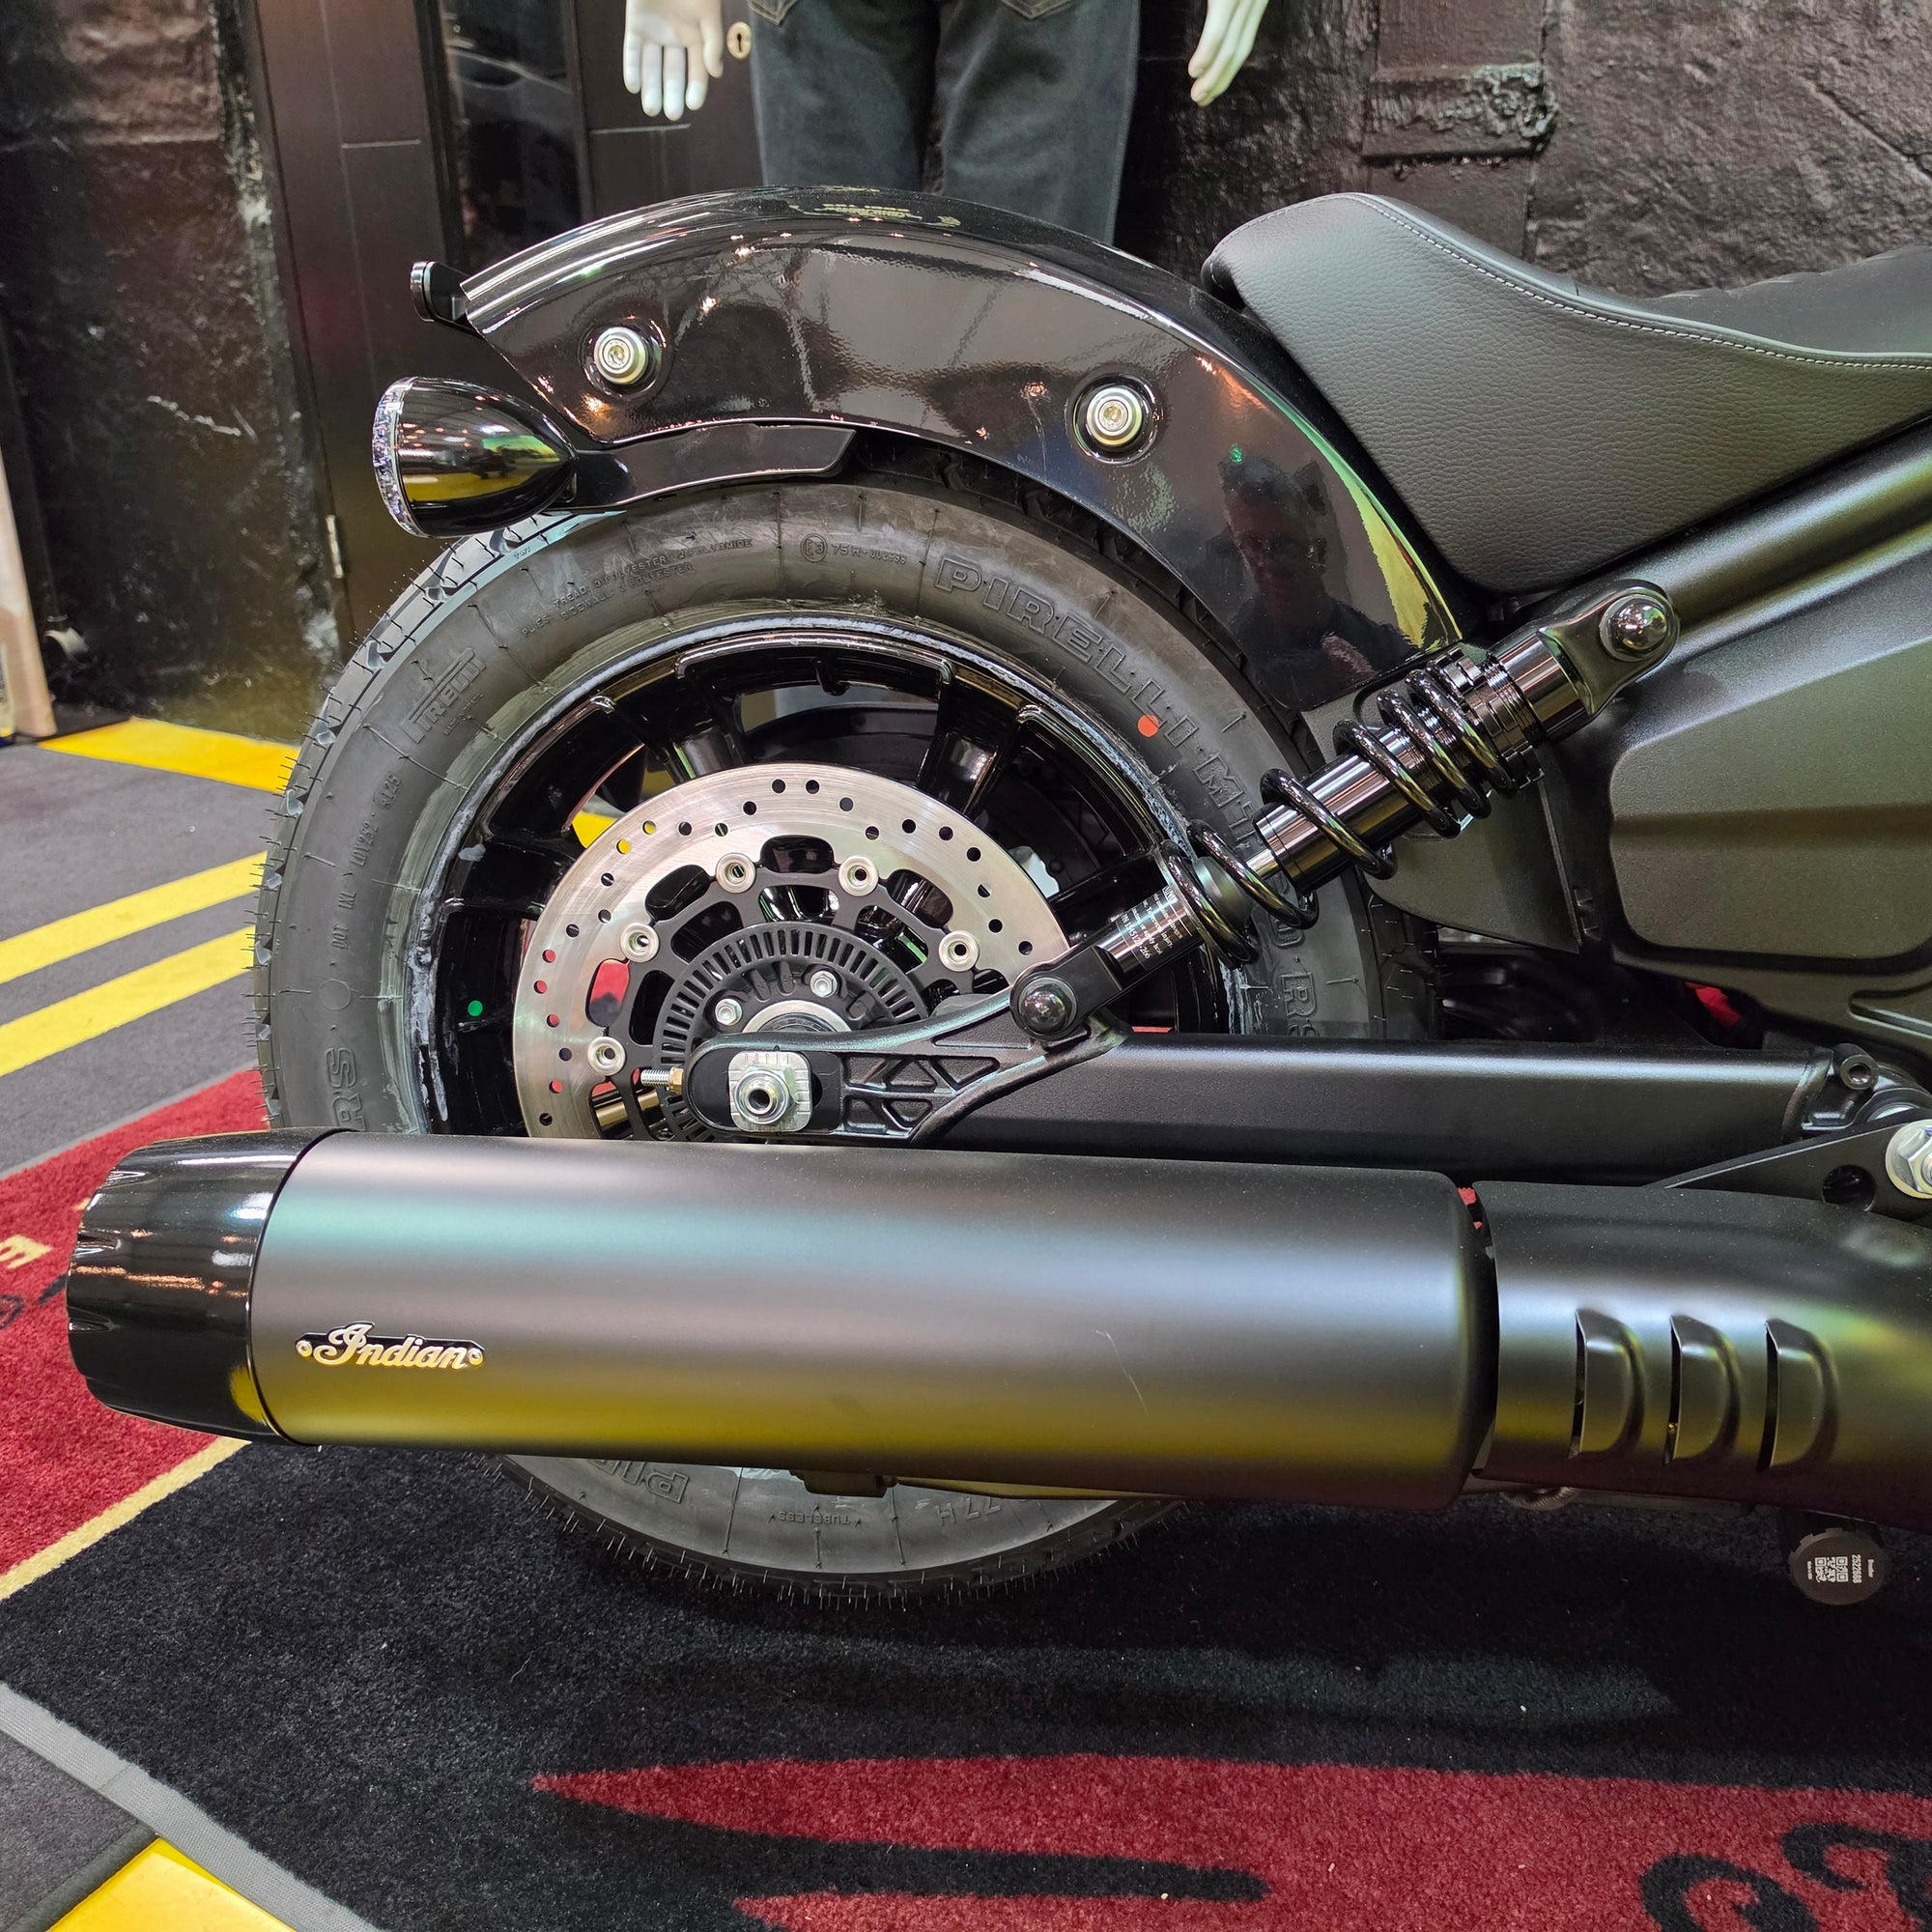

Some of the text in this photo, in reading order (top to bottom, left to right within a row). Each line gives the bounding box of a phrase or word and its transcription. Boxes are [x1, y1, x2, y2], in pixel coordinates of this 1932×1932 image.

[933, 557, 1199, 747] PIRELLI
[398, 647, 487, 744] PIRELLI
[330, 924, 350, 950] DOT
[325, 1046, 367, 1132] RS
[312, 1321, 468, 1370] Indian
[777, 1509, 852, 1526] TUBELESS
